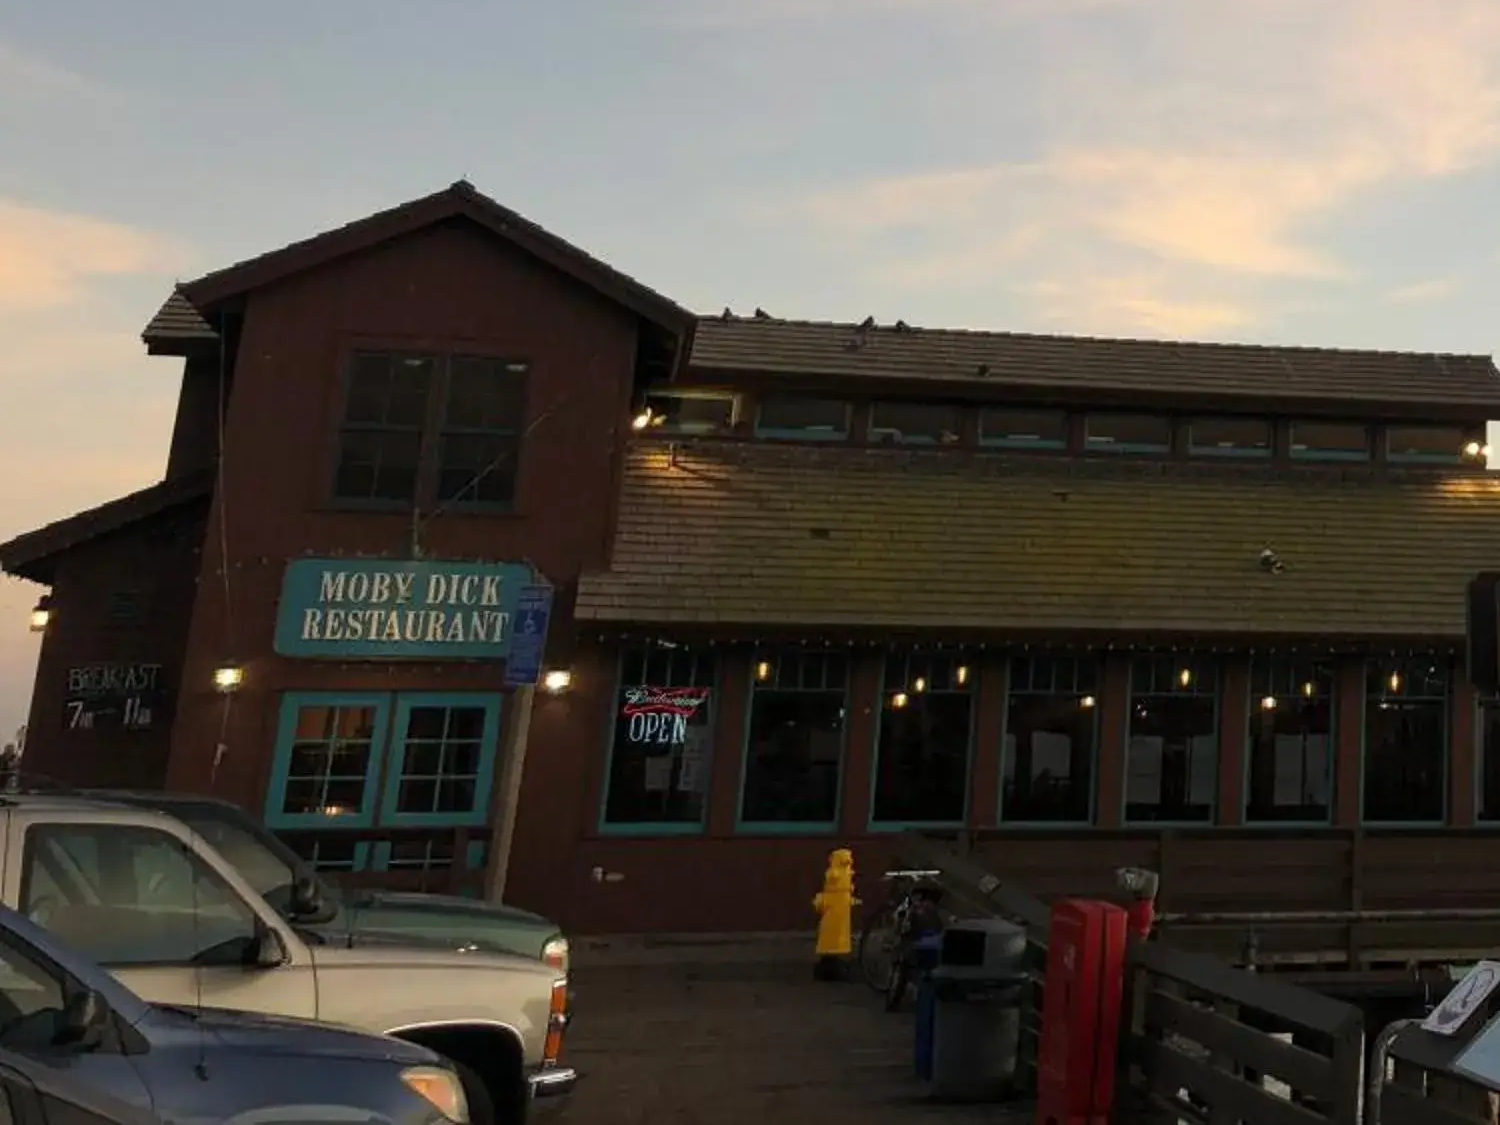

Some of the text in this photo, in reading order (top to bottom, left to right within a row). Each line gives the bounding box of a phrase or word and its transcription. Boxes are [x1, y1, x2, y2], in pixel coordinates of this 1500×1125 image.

[319, 571, 503, 606] MOBY DICK
[301, 608, 510, 644] RESTAURANT
[629, 712, 687, 744] OPEN
